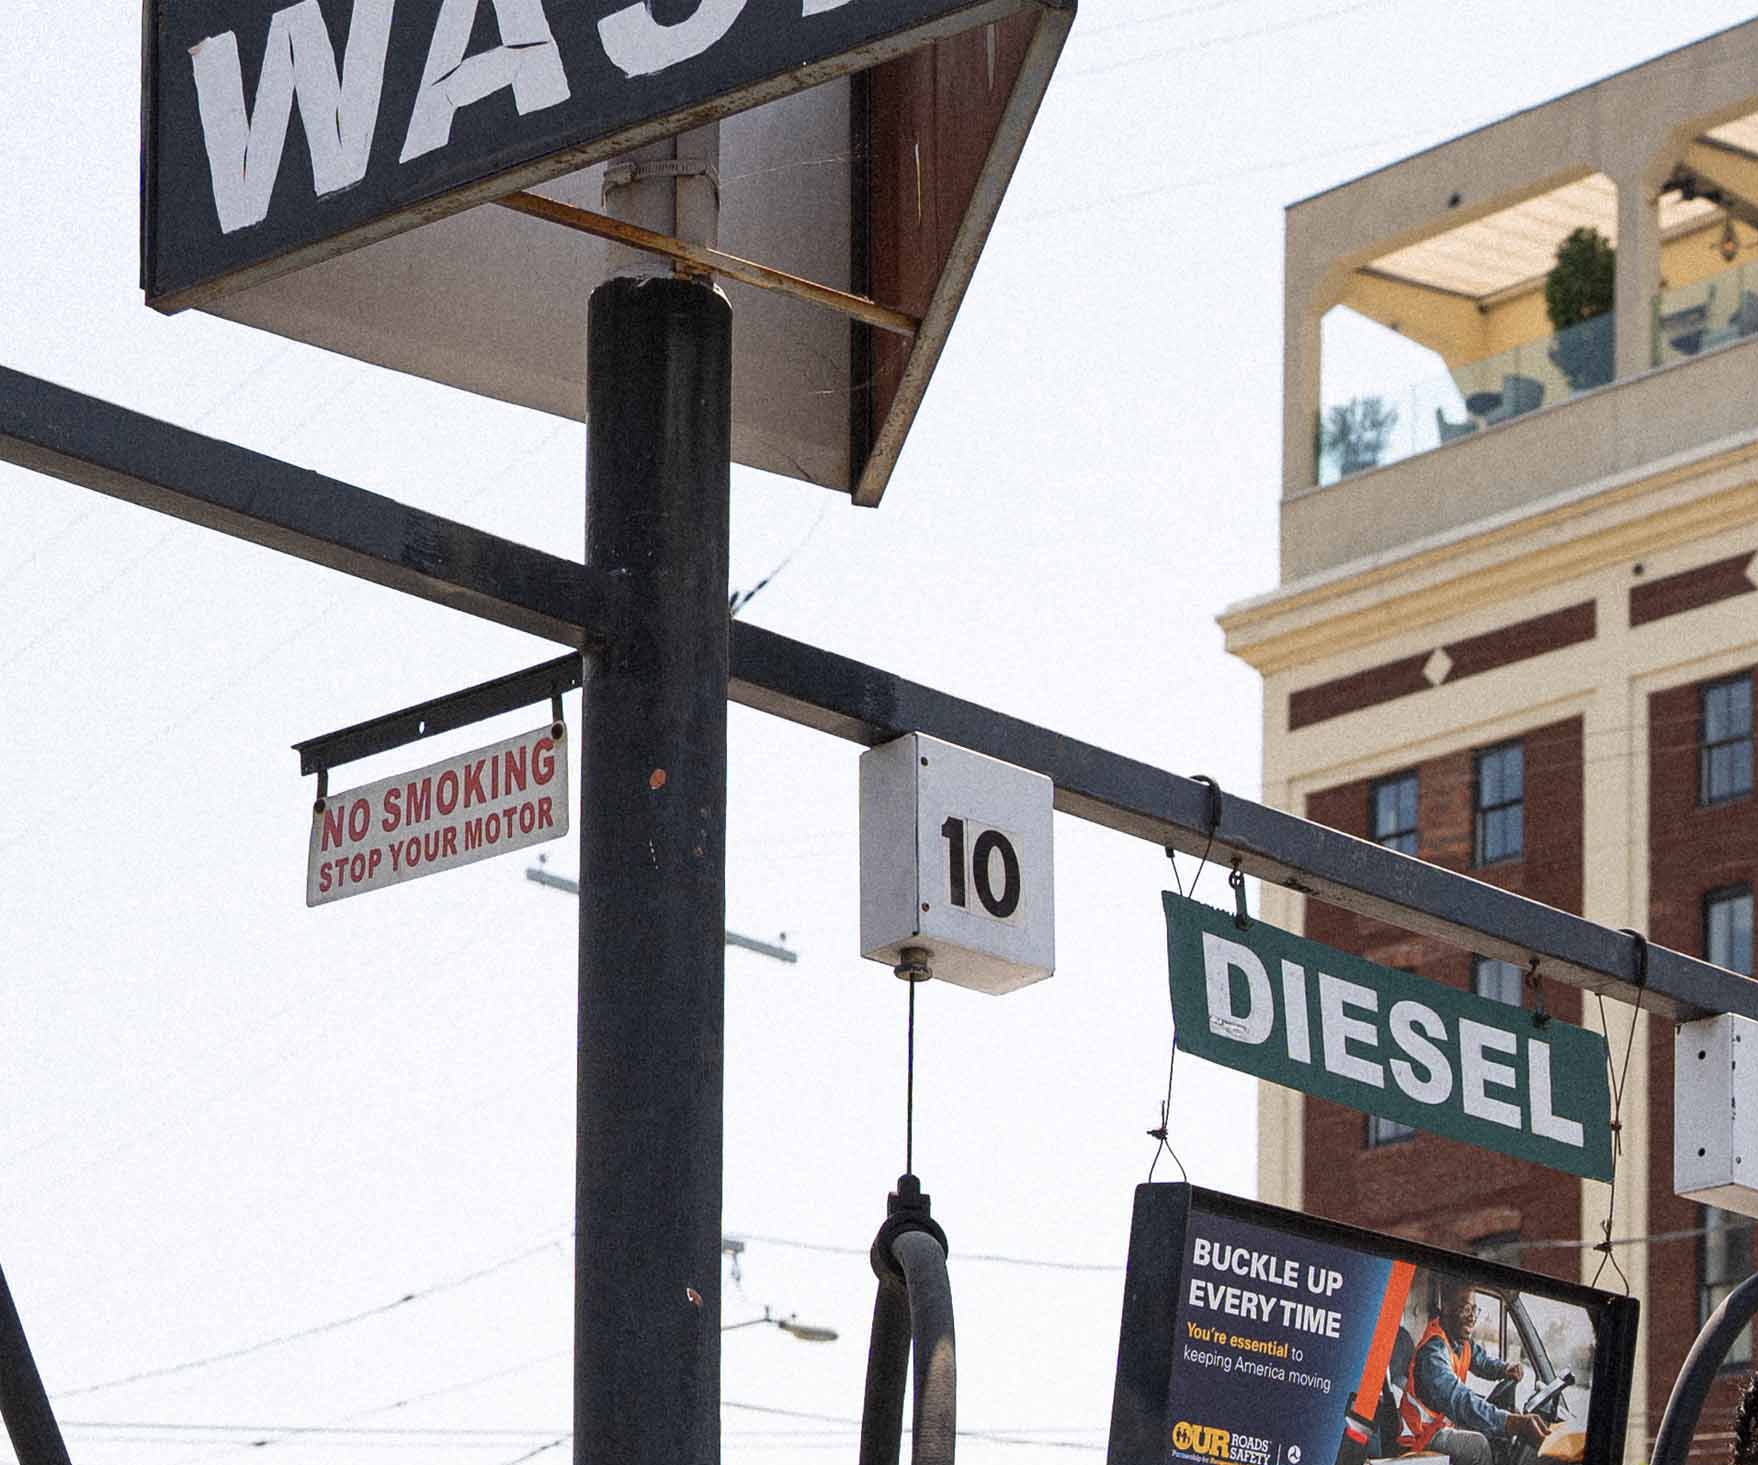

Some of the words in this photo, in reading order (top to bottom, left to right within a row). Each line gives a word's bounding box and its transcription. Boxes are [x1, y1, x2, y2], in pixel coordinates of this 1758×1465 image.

[187, 0, 852, 233] WA
[321, 801, 370, 852] NO
[381, 738, 557, 832] SMOKING
[318, 849, 381, 894] STOP
[389, 829, 457, 883] YOUR
[464, 796, 555, 869] MOTOR
[940, 816, 1021, 919] 10
[1202, 931, 1585, 1149] DIESEL
[1192, 1237, 1300, 1288] BUCKLE
[1307, 1266, 1344, 1296] UP
[1189, 1278, 1277, 1323] EVERY
[1280, 1299, 1342, 1338] TIME
[1183, 1344, 1232, 1373] keeping
[1234, 1356, 1285, 1381] America
[1288, 1370, 1331, 1393] moving
[1187, 1321, 1226, 1345] You're
[1230, 1334, 1289, 1358] essential
[1291, 1348, 1304, 1362] to
[1172, 1420, 1231, 1458] OUR
[1230, 1447, 1271, 1465] SAFETY
